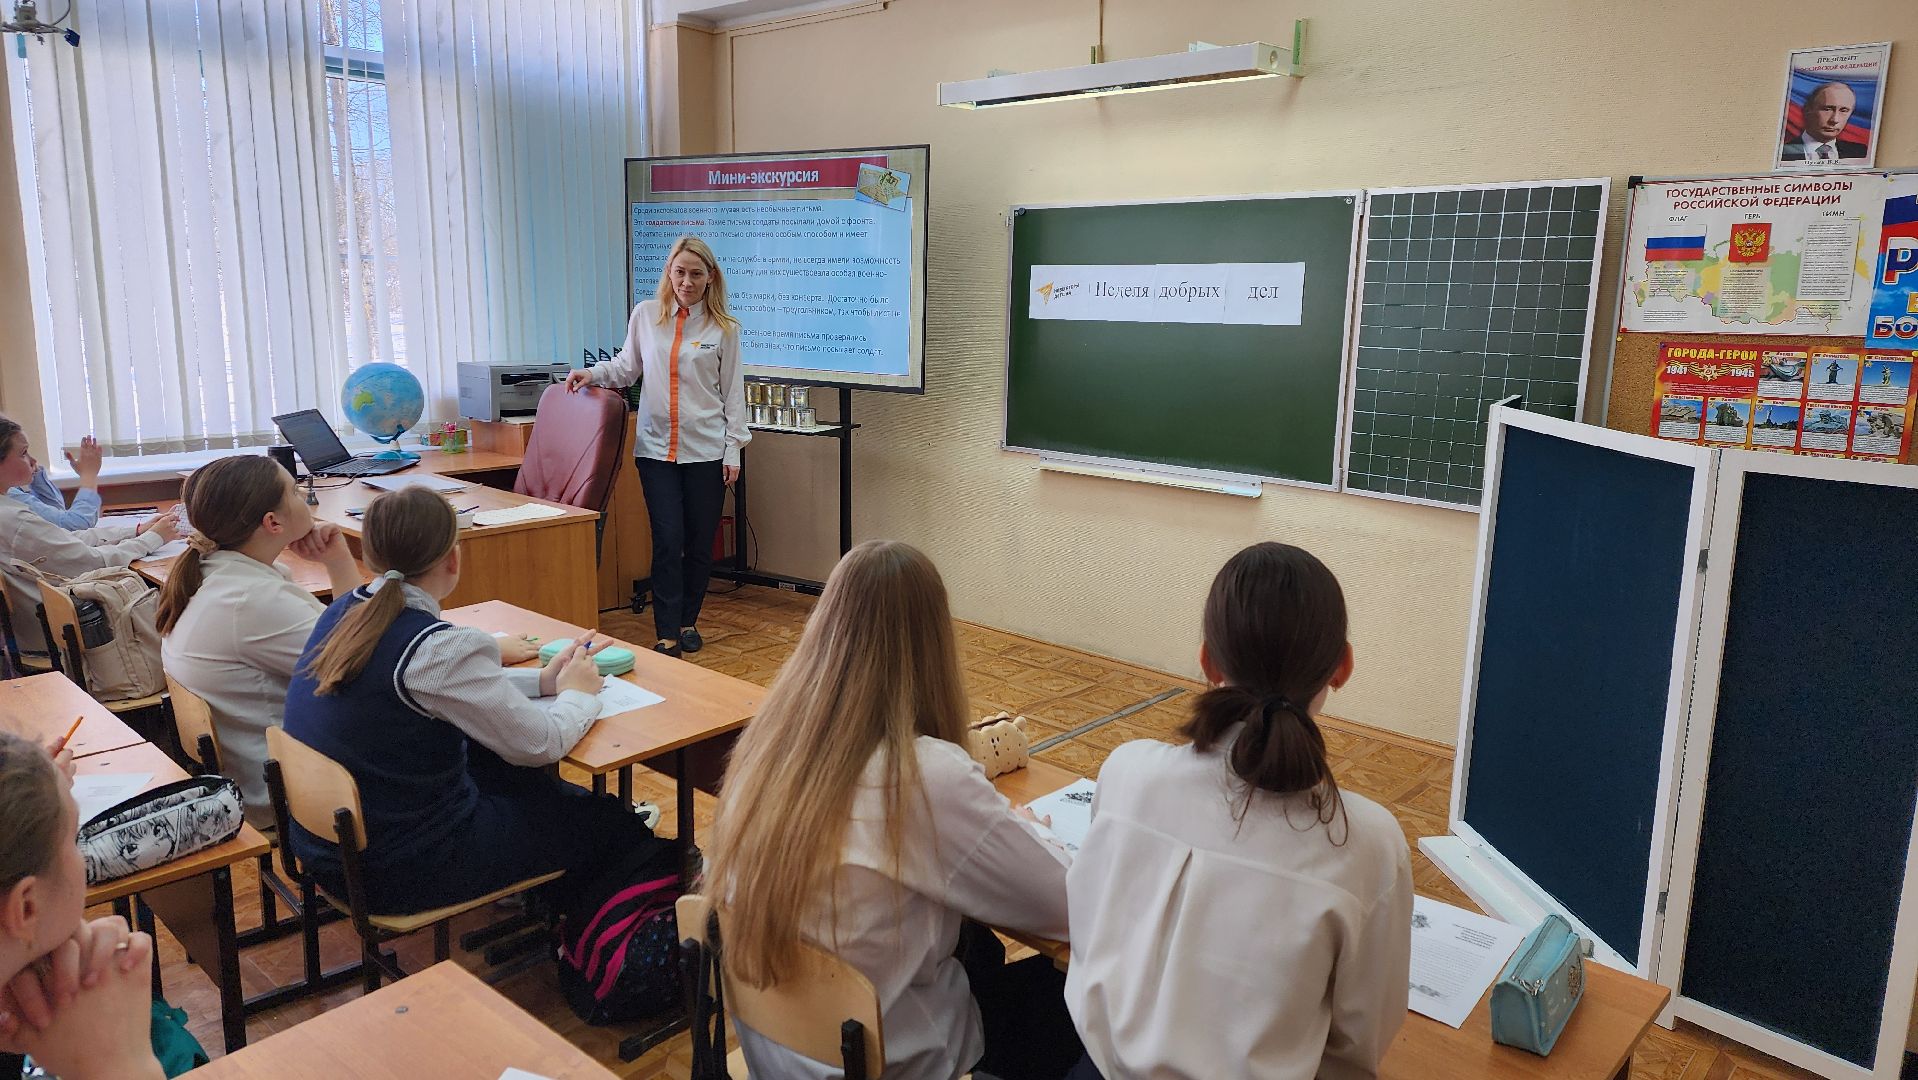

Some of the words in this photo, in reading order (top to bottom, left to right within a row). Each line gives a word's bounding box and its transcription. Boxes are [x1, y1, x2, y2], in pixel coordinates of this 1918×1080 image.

[708, 170, 819, 187] Мини-экскурсия
[1666, 184, 1780, 198] ГОСУДАРСТВЕННЫЕ
[1784, 181, 1853, 193] СИМВОЛЫ
[1673, 196, 1759, 210] РОССИЙСКОЙ
[1763, 195, 1841, 208] ФЕДЕРАЦИИ
[1095, 281, 1150, 299] Неделя
[1158, 280, 1220, 302] добрых
[1247, 286, 1279, 301] дел
[1667, 347, 1757, 361] ГОРОДА-ГЕРОИ
[1666, 365, 1688, 375] 1941
[1730, 368, 1755, 378] 1945
